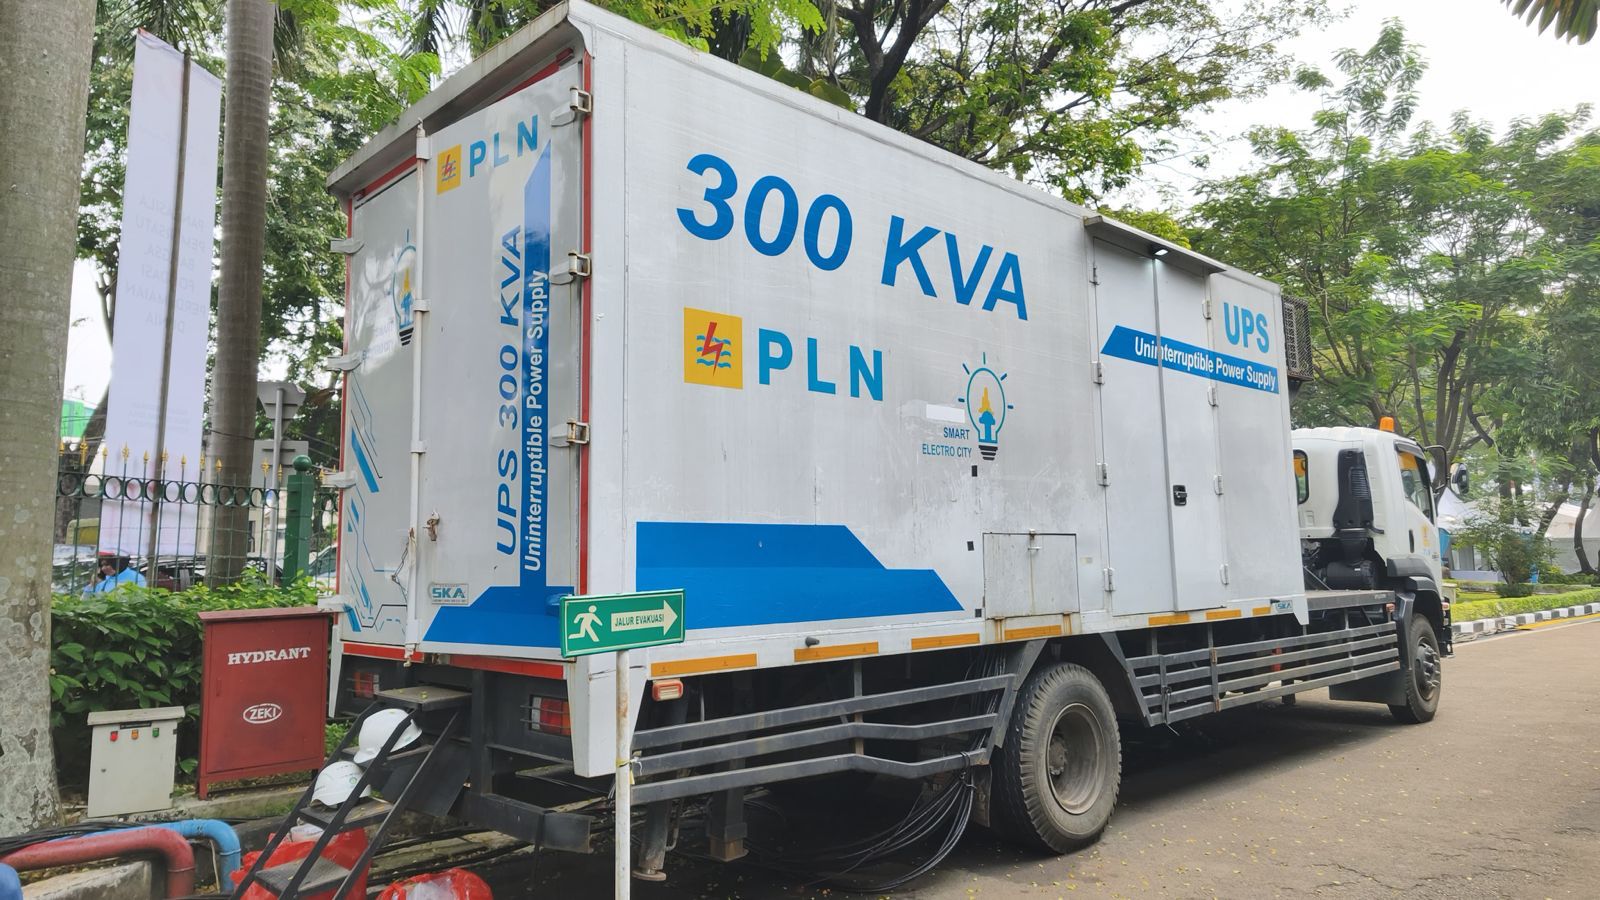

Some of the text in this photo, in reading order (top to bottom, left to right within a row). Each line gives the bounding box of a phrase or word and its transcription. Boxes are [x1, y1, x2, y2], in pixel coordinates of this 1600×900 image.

[469, 114, 539, 177] PLN
[676, 153, 1028, 321] 300 KVA
[1223, 302, 1270, 353] UPS
[758, 327, 883, 402] PLN
[1134, 336, 1276, 391] Uninterruptible Power Supply
[496, 224, 521, 556] UPS 300 KVA
[524, 270, 549, 571] Uninterruptible Power Supply
[943, 427, 970, 440] SMART
[922, 443, 972, 458] ELECTRO CITY
[432, 587, 465, 598] SKA
[615, 614, 664, 626] JALUR EVAKUASI
[228, 647, 311, 665] HYDRANT
[249, 708, 276, 719] ZEKI
